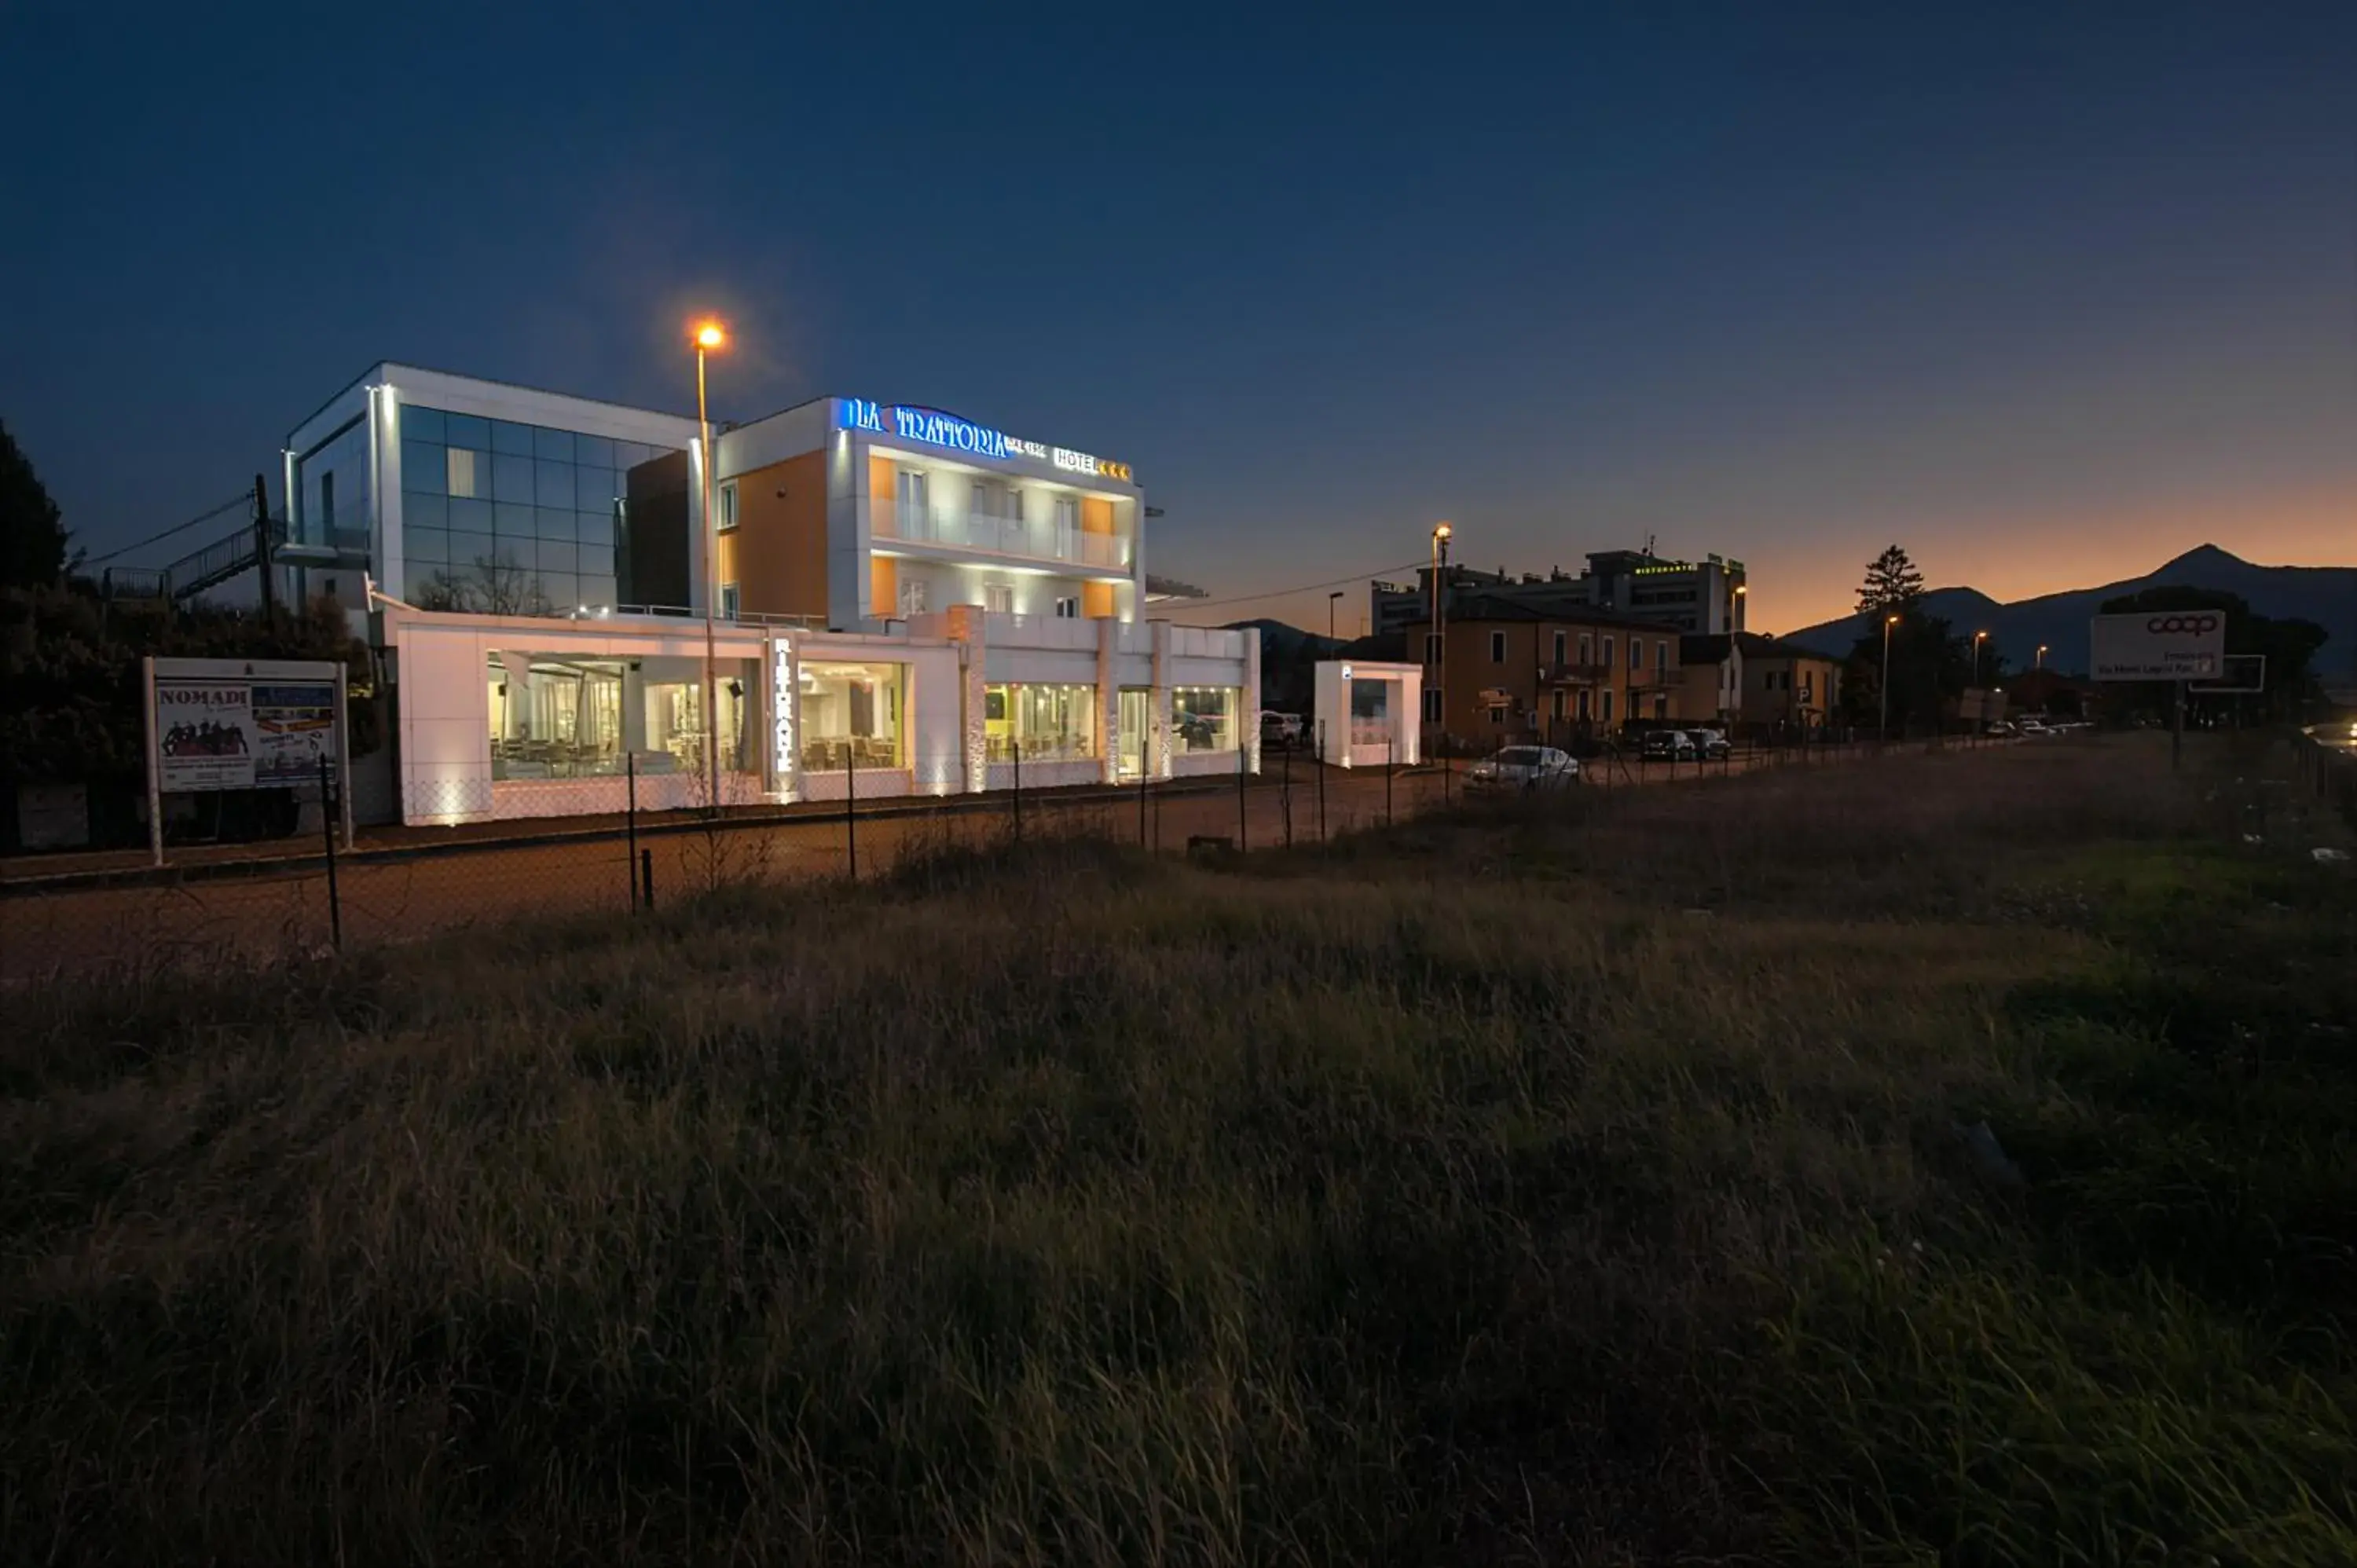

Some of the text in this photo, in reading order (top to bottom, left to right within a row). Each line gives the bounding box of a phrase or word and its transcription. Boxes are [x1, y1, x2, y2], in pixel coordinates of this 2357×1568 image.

[854, 398, 883, 431] LA
[896, 406, 1006, 458] TRATTORIA
[1056, 448, 1098, 474] HOTEL
[159, 690, 248, 705] NOMADI
[1799, 688, 1810, 702] P
